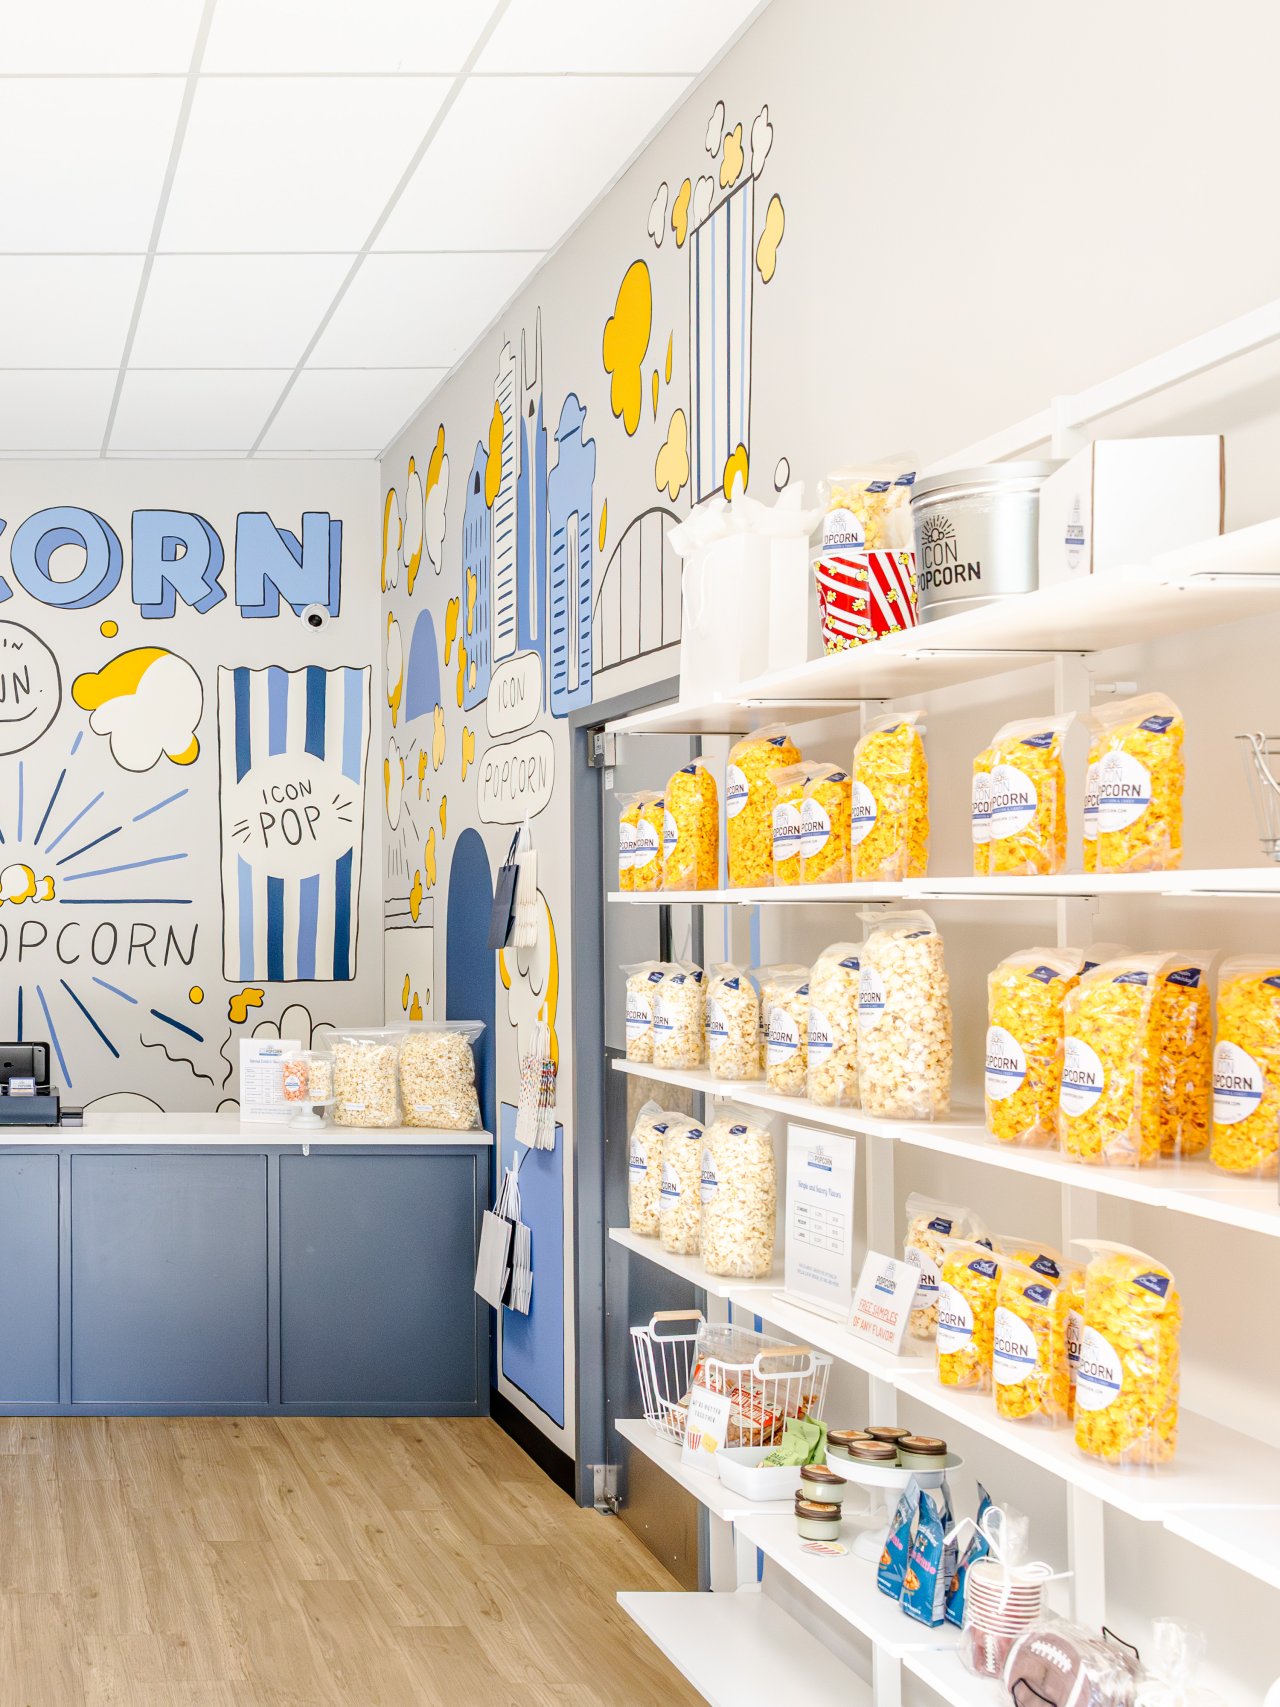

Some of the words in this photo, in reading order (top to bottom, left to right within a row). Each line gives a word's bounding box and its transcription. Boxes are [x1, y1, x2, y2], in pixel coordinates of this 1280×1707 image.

[824, 532, 858, 545] OPCORN
[922, 539, 958, 571] ICON
[3, 638, 23, 650] IN
[498, 671, 526, 712] ICON
[262, 779, 312, 805] ICON
[483, 756, 547, 802] POPCORN
[259, 805, 321, 848] POP
[852, 1315, 861, 1328] OF
[860, 1319, 872, 1333] ANY
[859, 1298, 874, 1313] FREE
[873, 1303, 899, 1325] SAMPLES
